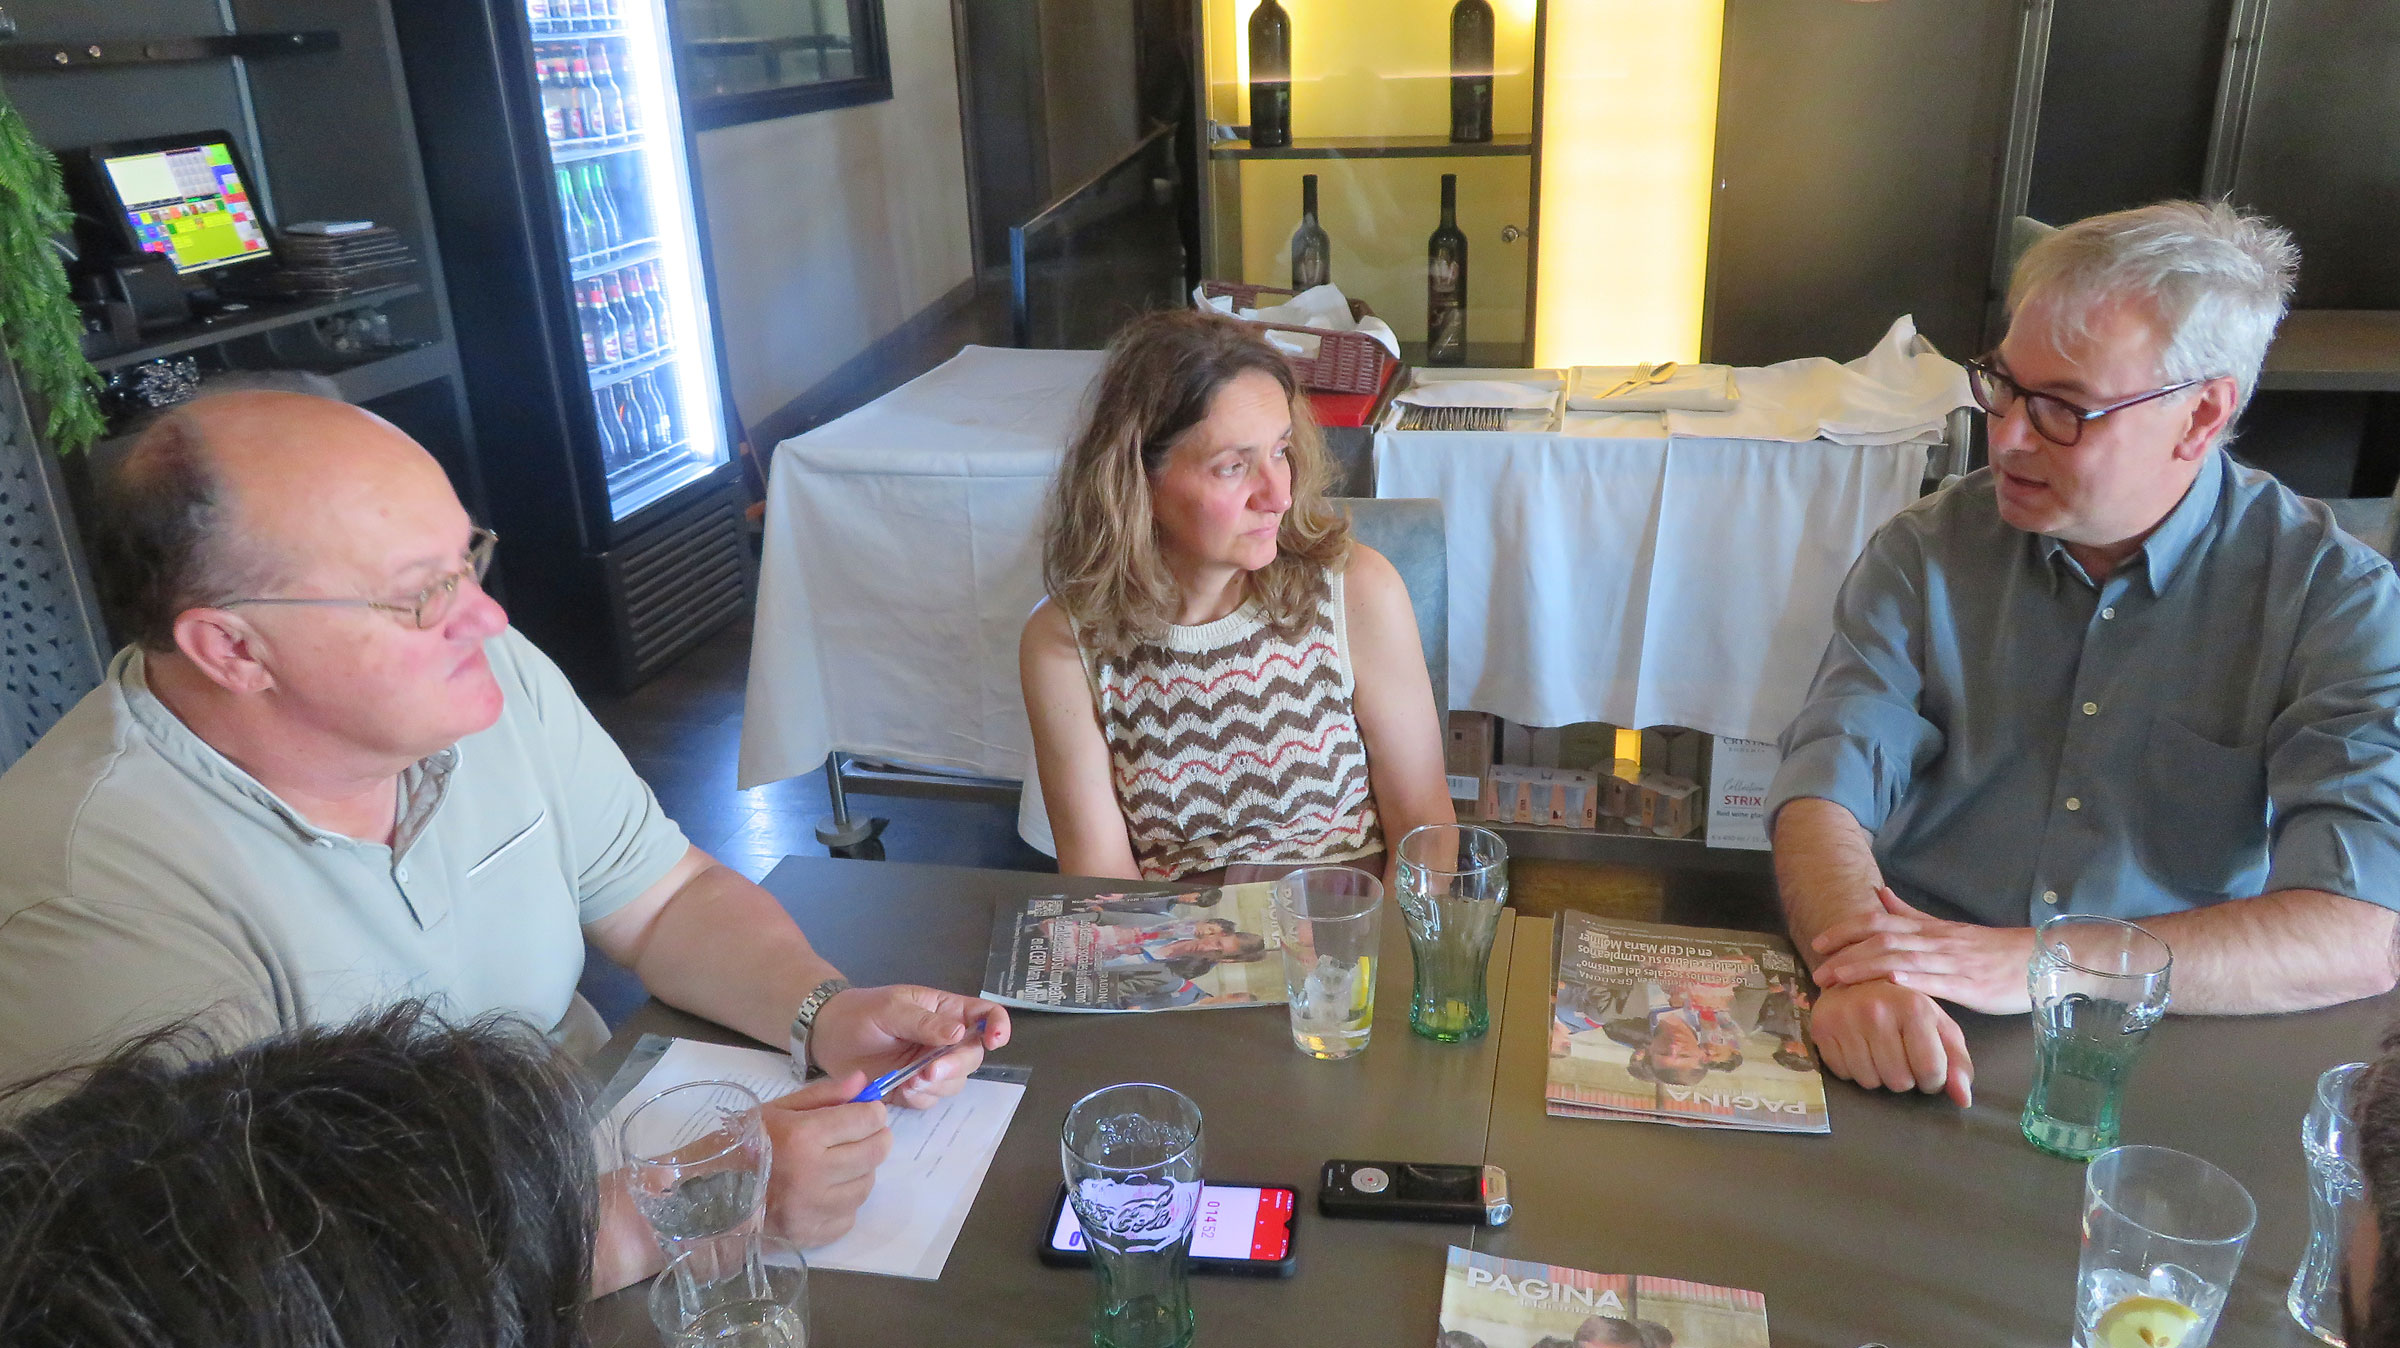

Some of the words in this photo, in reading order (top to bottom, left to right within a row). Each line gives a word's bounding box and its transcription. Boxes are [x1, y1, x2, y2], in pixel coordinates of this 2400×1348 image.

[1724, 794, 1761, 806] STRIX
[1586, 808, 1592, 818] 6
[1577, 944, 1646, 962] cumpleaños
[1660, 944, 1684, 956] CEIP
[1686, 947, 1697, 957] el
[1699, 949, 1713, 957] en
[1648, 954, 1661, 964] su
[1625, 967, 1641, 977] del
[1643, 968, 1684, 980] sociales
[1467, 1266, 1625, 1311] PAGINA
